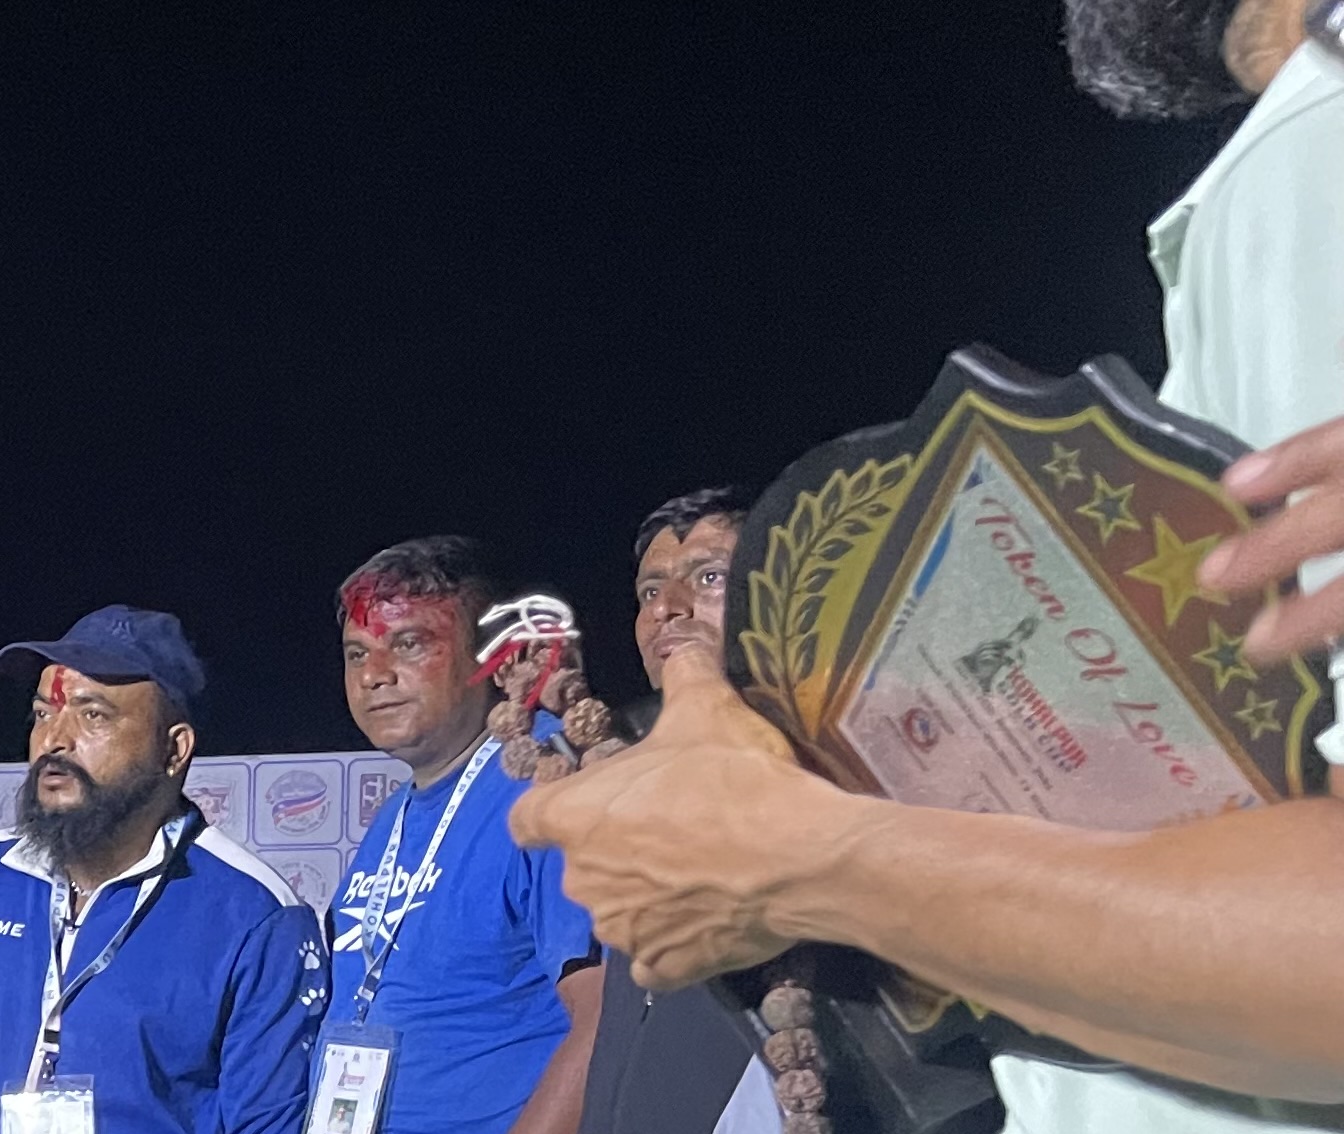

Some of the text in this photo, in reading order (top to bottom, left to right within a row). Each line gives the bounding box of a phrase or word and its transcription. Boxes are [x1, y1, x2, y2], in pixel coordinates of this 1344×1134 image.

[975, 497, 1065, 620] Token
[1064, 627, 1129, 681] Of
[1113, 702, 1198, 787] Love
[341, 862, 443, 905] Rebk
